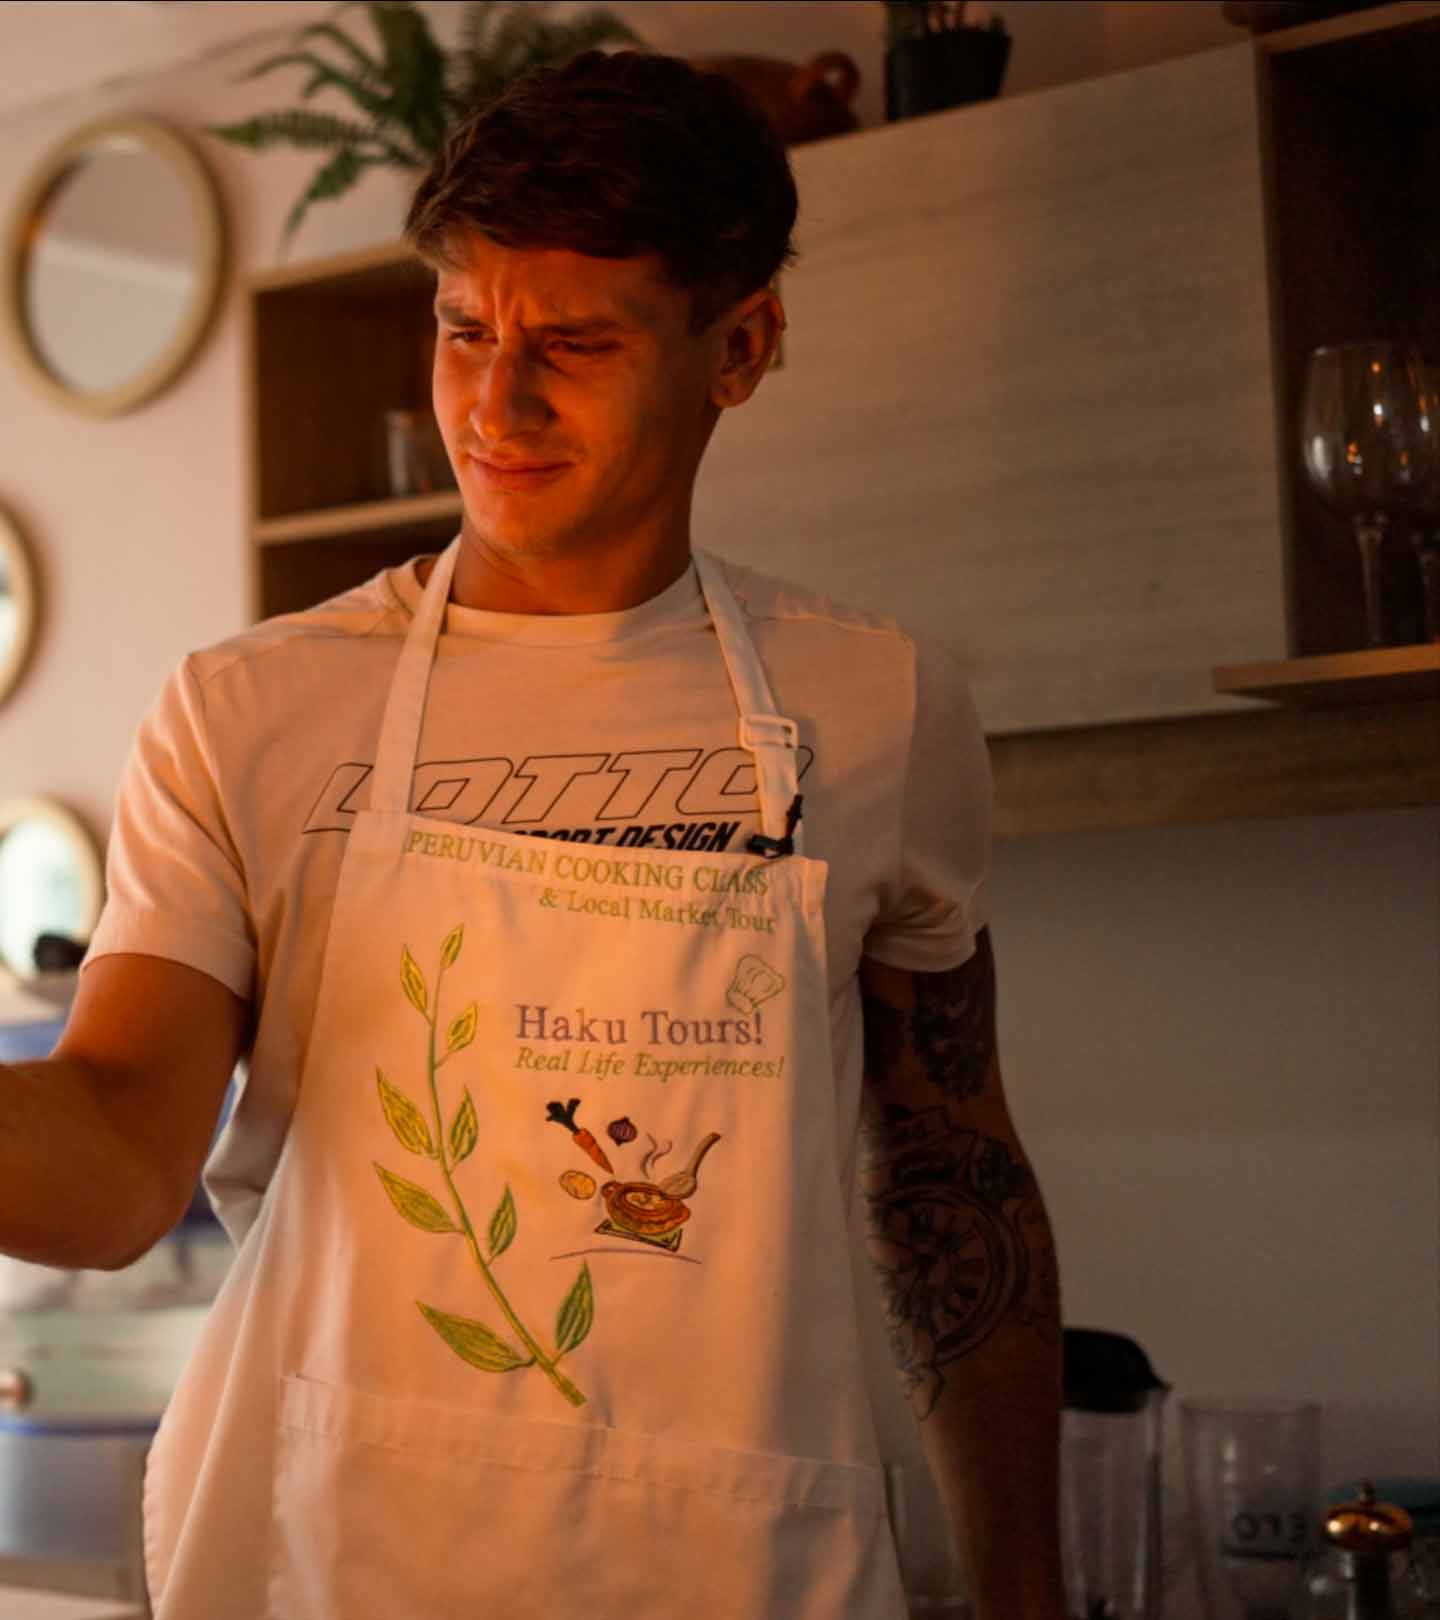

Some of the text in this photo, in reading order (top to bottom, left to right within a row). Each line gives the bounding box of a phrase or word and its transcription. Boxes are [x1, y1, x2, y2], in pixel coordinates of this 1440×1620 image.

[409, 830, 769, 897] PERUVIAN COOKING CLASS
[539, 887, 776, 934] & Local Market Tour
[515, 1004, 763, 1045] Haku Tours!
[515, 1047, 784, 1083] Real Life Experiences!
